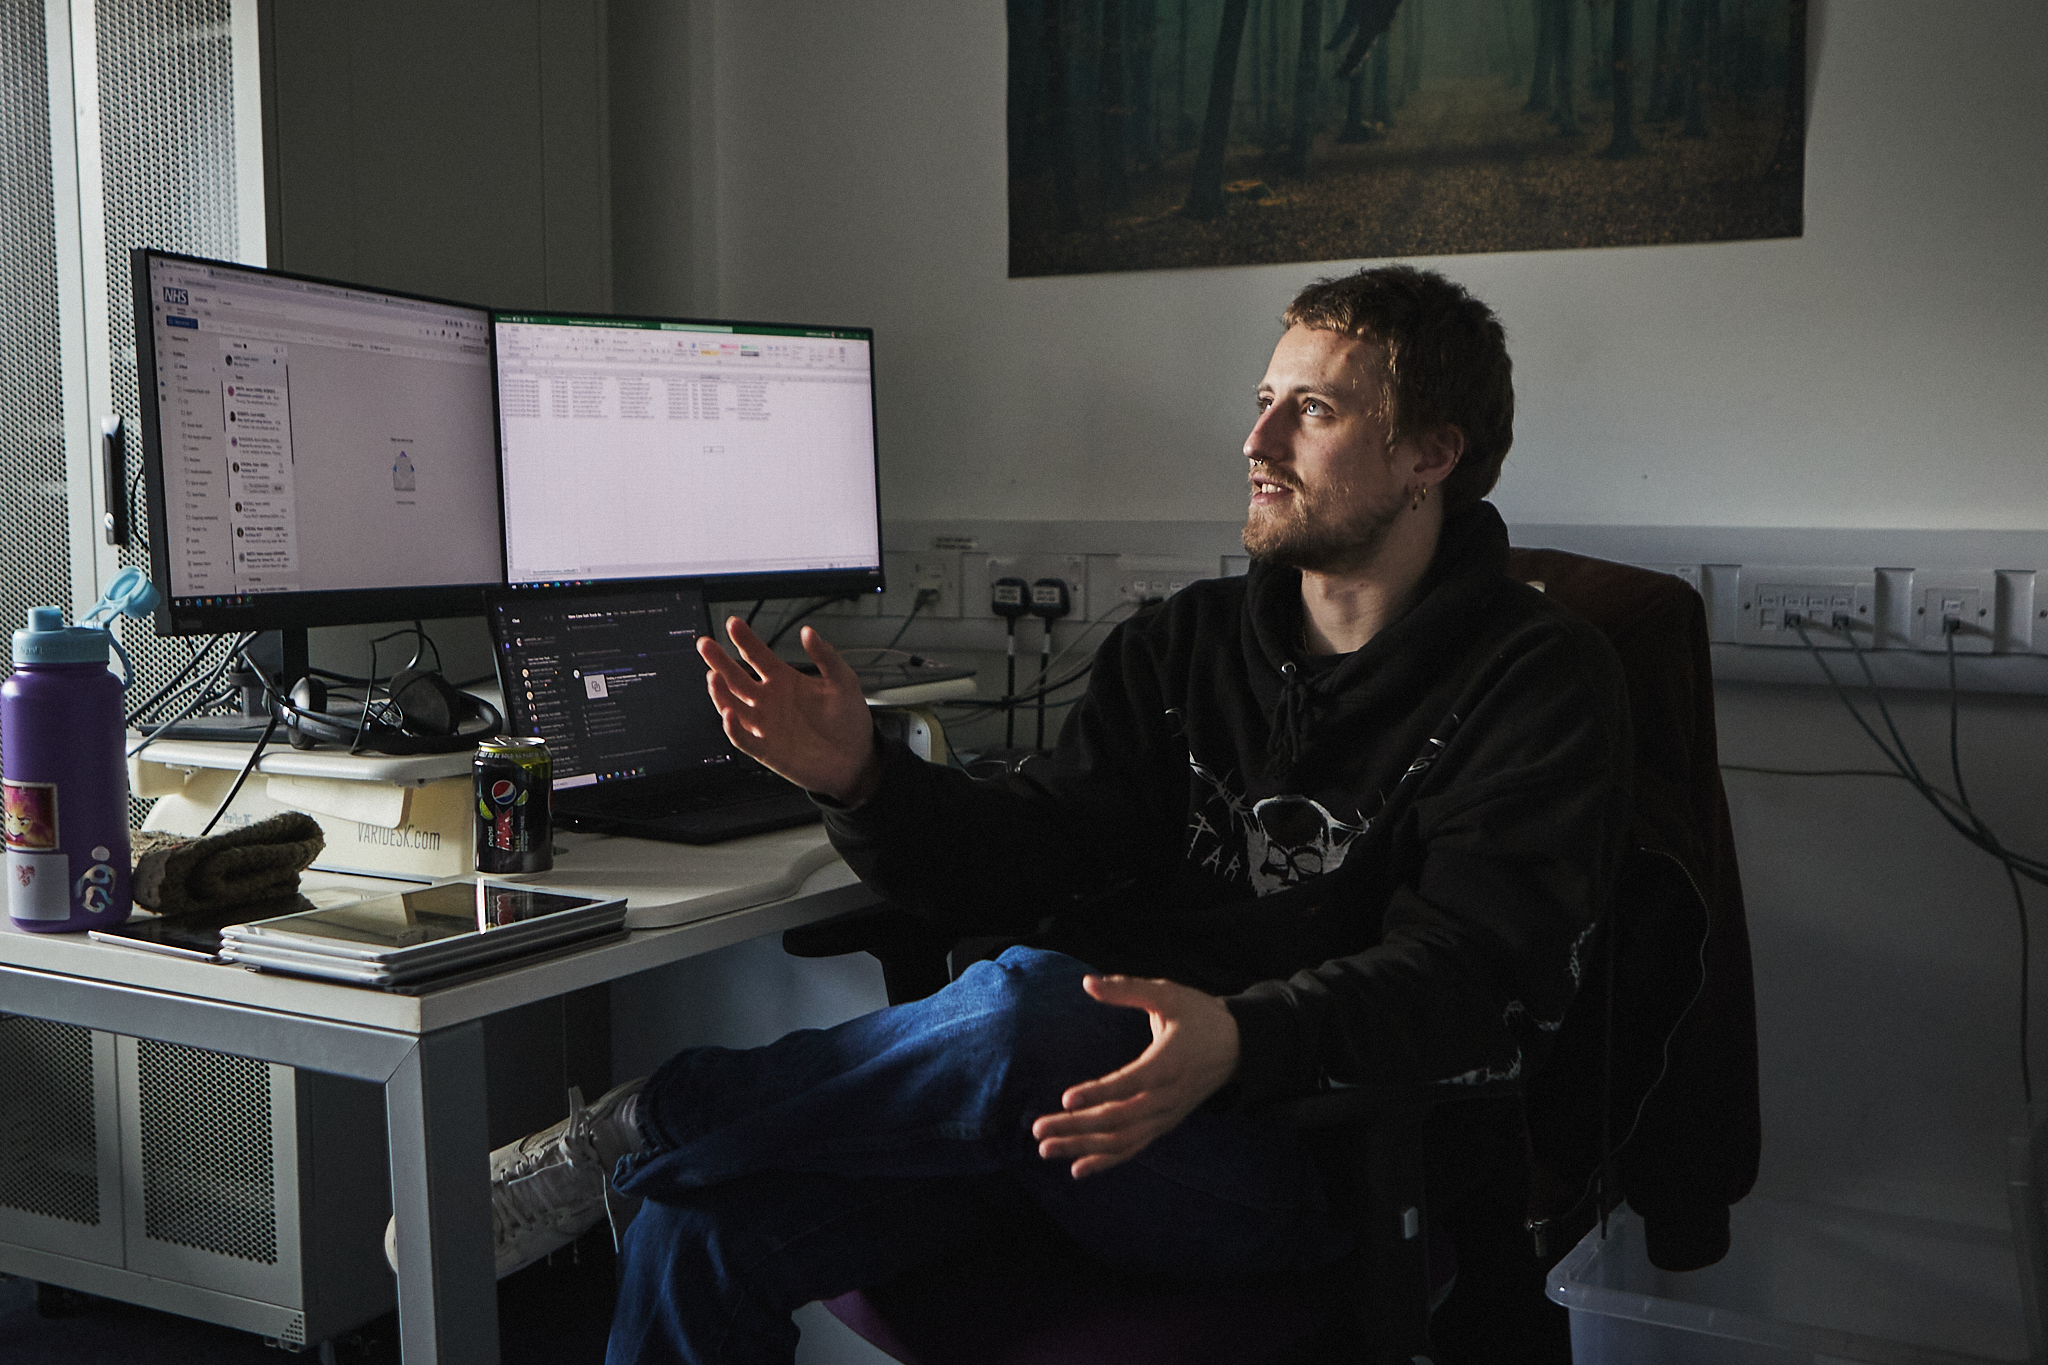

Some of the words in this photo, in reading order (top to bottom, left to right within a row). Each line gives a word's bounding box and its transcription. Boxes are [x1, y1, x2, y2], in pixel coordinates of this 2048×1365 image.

[164, 288, 187, 303] NHS
[487, 825, 495, 847] pepsi
[494, 803, 514, 852] MAX
